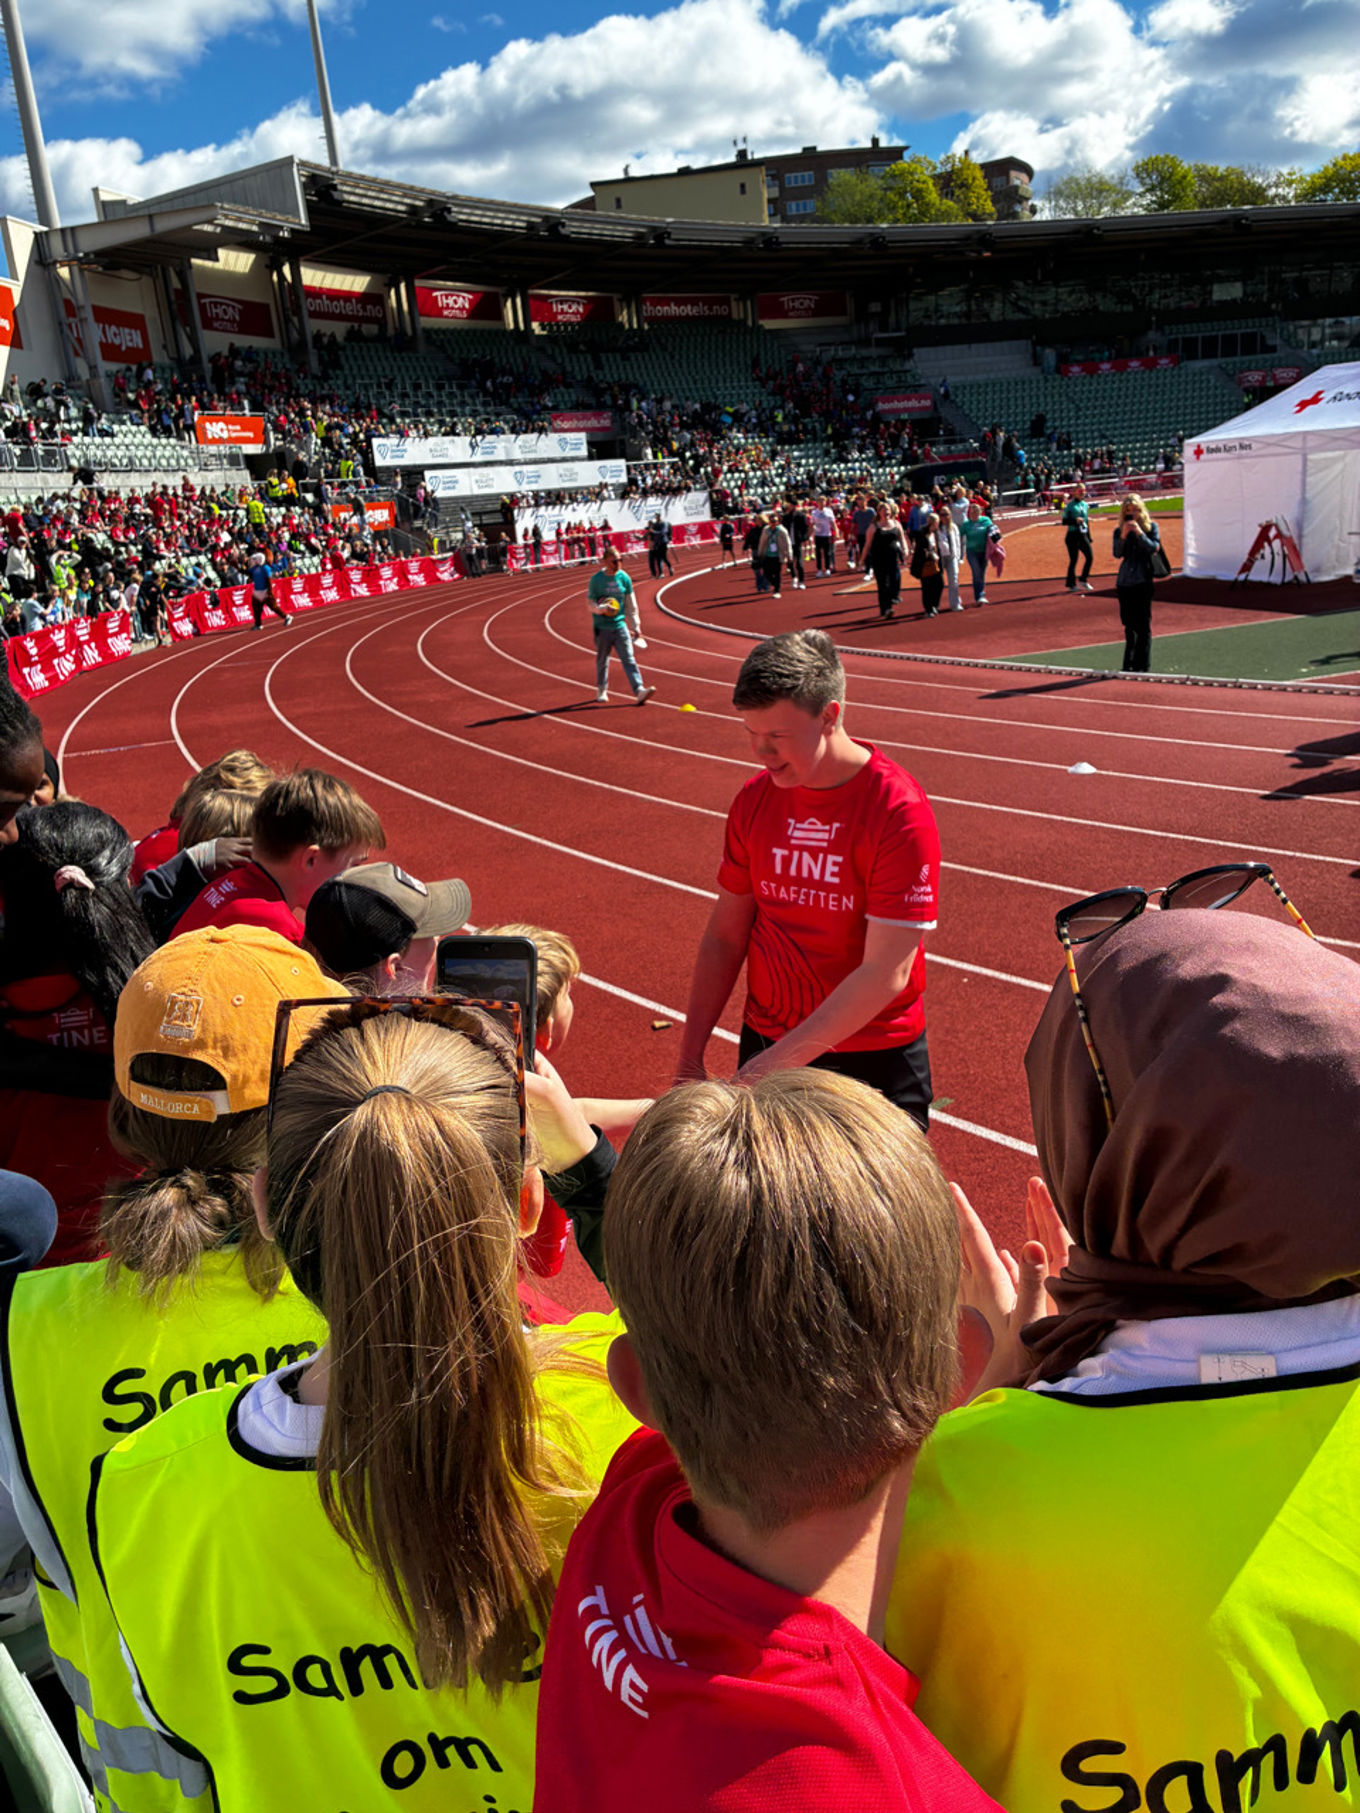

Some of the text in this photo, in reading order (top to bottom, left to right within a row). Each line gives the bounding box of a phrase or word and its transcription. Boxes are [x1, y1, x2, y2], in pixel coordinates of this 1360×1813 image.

[200, 298, 243, 321] THON
[306, 295, 384, 318] onhotels.no
[433, 290, 473, 309] THON
[548, 297, 587, 313] THON
[779, 294, 820, 309] THON
[771, 847, 844, 884] TINE
[760, 880, 854, 912] STAFETTEN
[47, 1026, 108, 1048] TINE
[139, 1092, 201, 1115] MALLORCA
[577, 1585, 649, 1720] TINE
[381, 1732, 504, 1790] om
